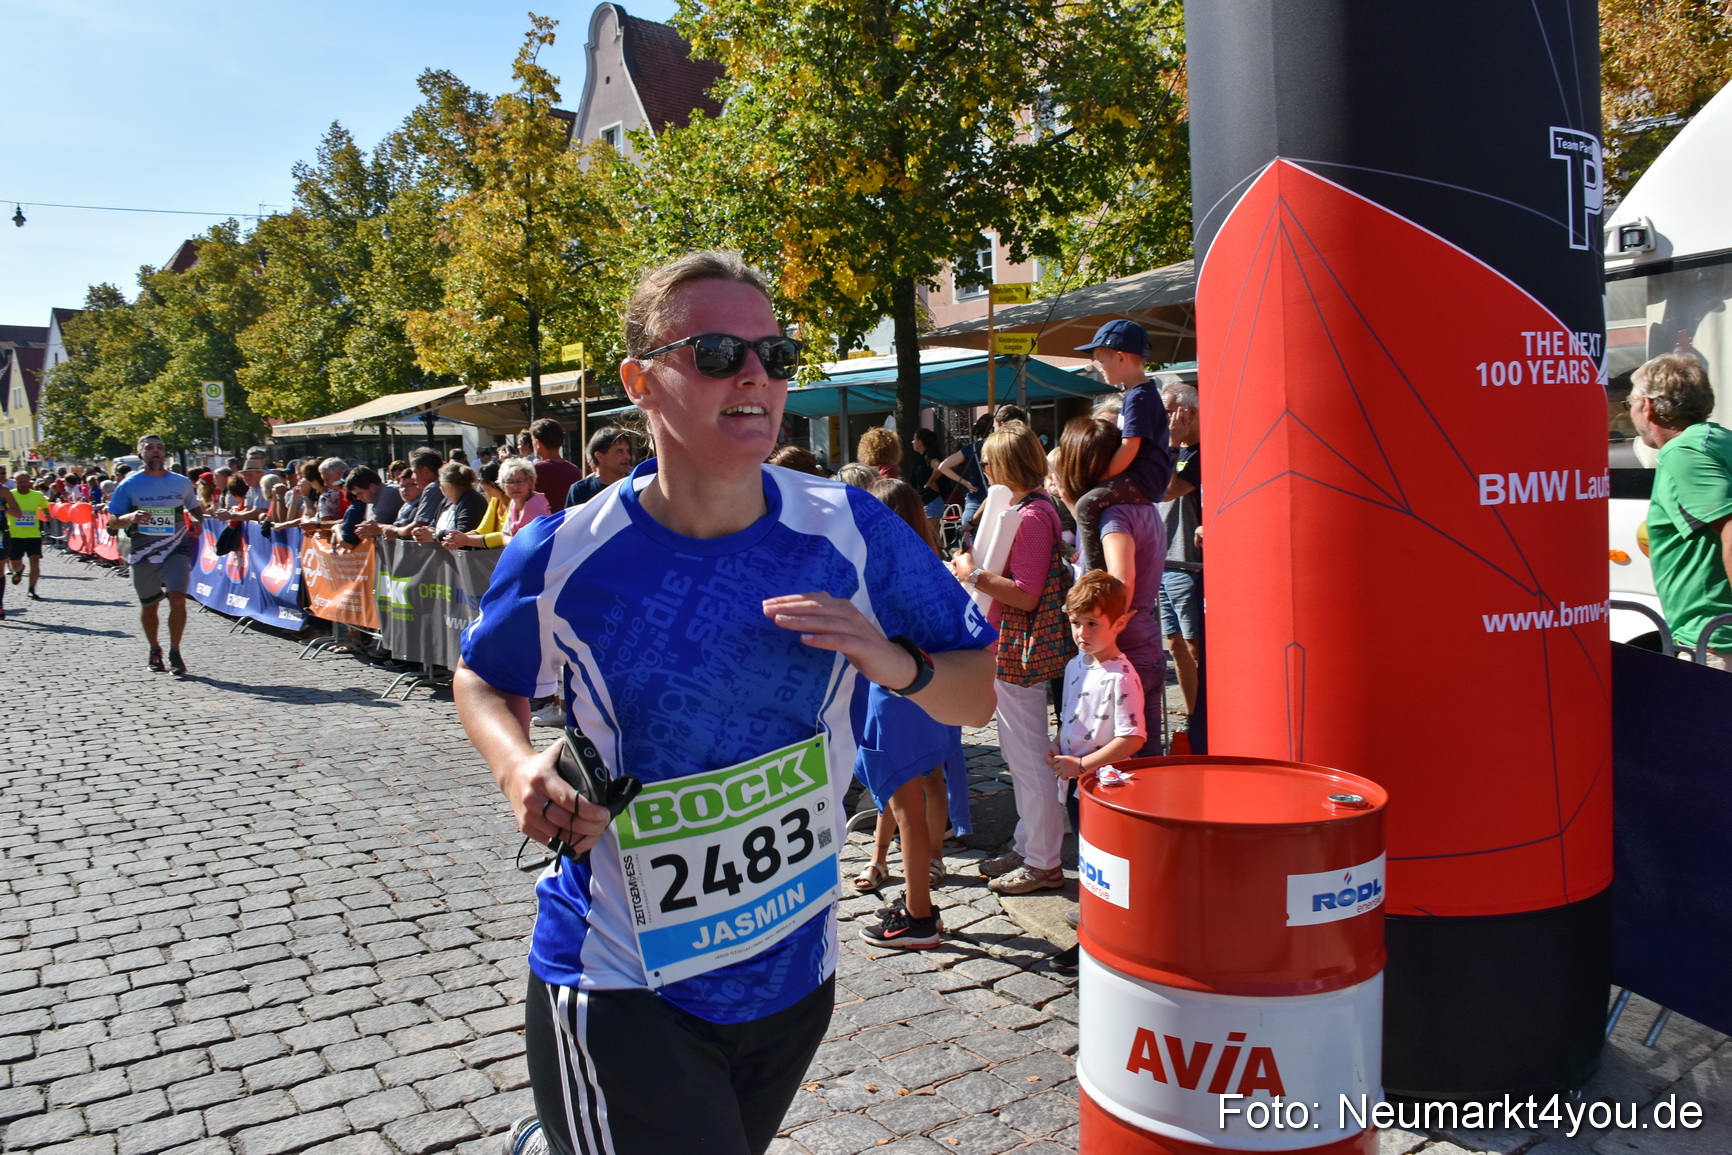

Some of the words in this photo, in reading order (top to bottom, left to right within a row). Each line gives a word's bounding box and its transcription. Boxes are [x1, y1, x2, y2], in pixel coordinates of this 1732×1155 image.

[1521, 331, 1565, 356] THE
[1569, 332, 1602, 357] NEXT
[1475, 360, 1523, 387] 100
[1526, 360, 1590, 385] YEARS
[1479, 470, 1569, 506] BMW
[632, 757, 813, 837] BOCK
[650, 807, 814, 914] 2483
[691, 882, 807, 950] JASMIN
